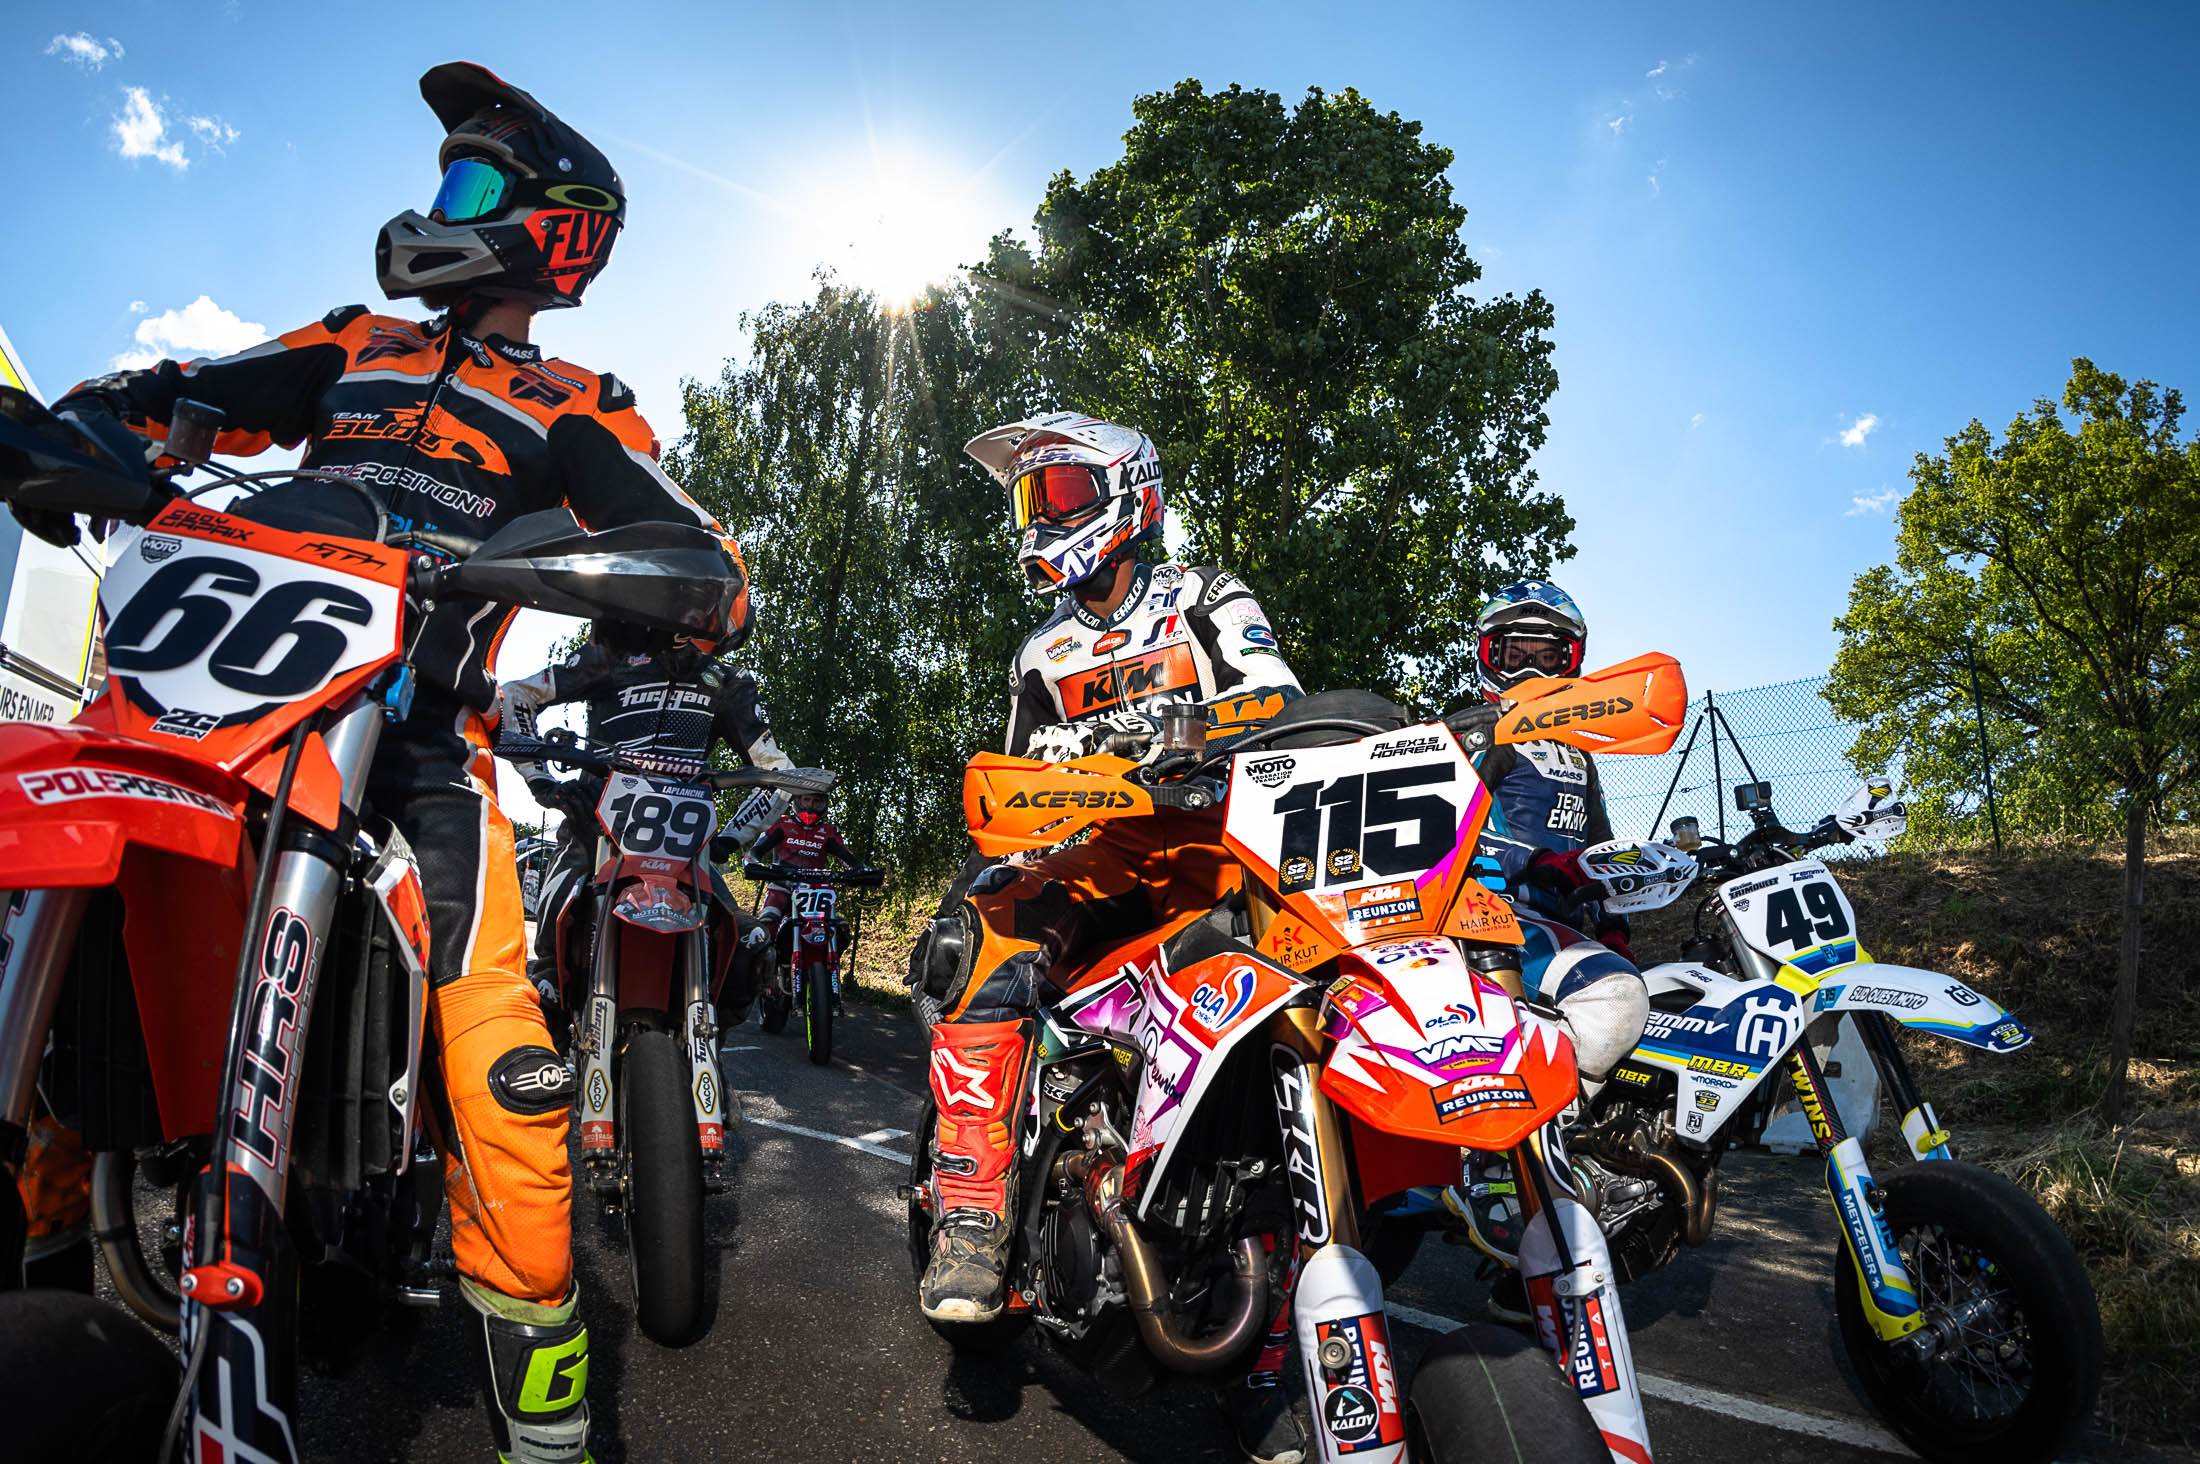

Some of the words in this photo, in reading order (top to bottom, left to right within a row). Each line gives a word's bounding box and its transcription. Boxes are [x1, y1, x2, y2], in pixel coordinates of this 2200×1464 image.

[542, 212, 610, 267] FLY
[142, 539, 180, 553] MOTO
[105, 555, 373, 697] 66
[1081, 660, 1166, 709] KTM
[18, 694, 34, 721] EN
[1512, 697, 1634, 735] ACERBIS
[1370, 742, 1447, 760] HOAREAU
[1245, 757, 1297, 777] MOTO
[661, 785, 706, 799] LAPLANCHE
[1004, 791, 1135, 809] ACERBIS
[609, 792, 712, 858] 189
[1273, 761, 1457, 896] 115
[786, 837, 824, 850] GASGAS
[639, 859, 672, 872] KTM
[1287, 862, 1307, 876] S2
[1333, 854, 1354, 867] S2
[795, 891, 833, 913] 216
[1359, 885, 1401, 904] KTM
[1352, 900, 1416, 922] REUNION
[1766, 881, 1850, 952] 49
[1460, 917, 1490, 931] HAIR
[1491, 913, 1516, 926] KUT
[1294, 944, 1319, 960] KUT
[1194, 985, 1227, 1017] OLA
[1848, 985, 1871, 1003] SUD
[1868, 986, 1898, 1006] OUEST
[1895, 990, 1929, 1010] MOTO
[1194, 1008, 1214, 1026] ENERGY
[1424, 1012, 1463, 1030] OLA
[227, 906, 312, 1170] HRS
[2000, 1028, 2020, 1042] 33
[1112, 1047, 1132, 1068] MBR
[1411, 1034, 1506, 1067] VMC
[1687, 1054, 1751, 1078] MBR
[593, 1073, 603, 1110] YACCO
[702, 1075, 713, 1110] YACCO
[1451, 1075, 1505, 1096] KTM
[1695, 1075, 1733, 1090] MORACO
[1441, 1089, 1526, 1113] REUNION
[1456, 1100, 1521, 1117] TEAM
[1697, 1097, 1718, 1106] 33
[1842, 1193, 1878, 1276] METZELER
[1369, 1340, 1397, 1414] KTM
[1330, 1413, 1375, 1432] KALOY
